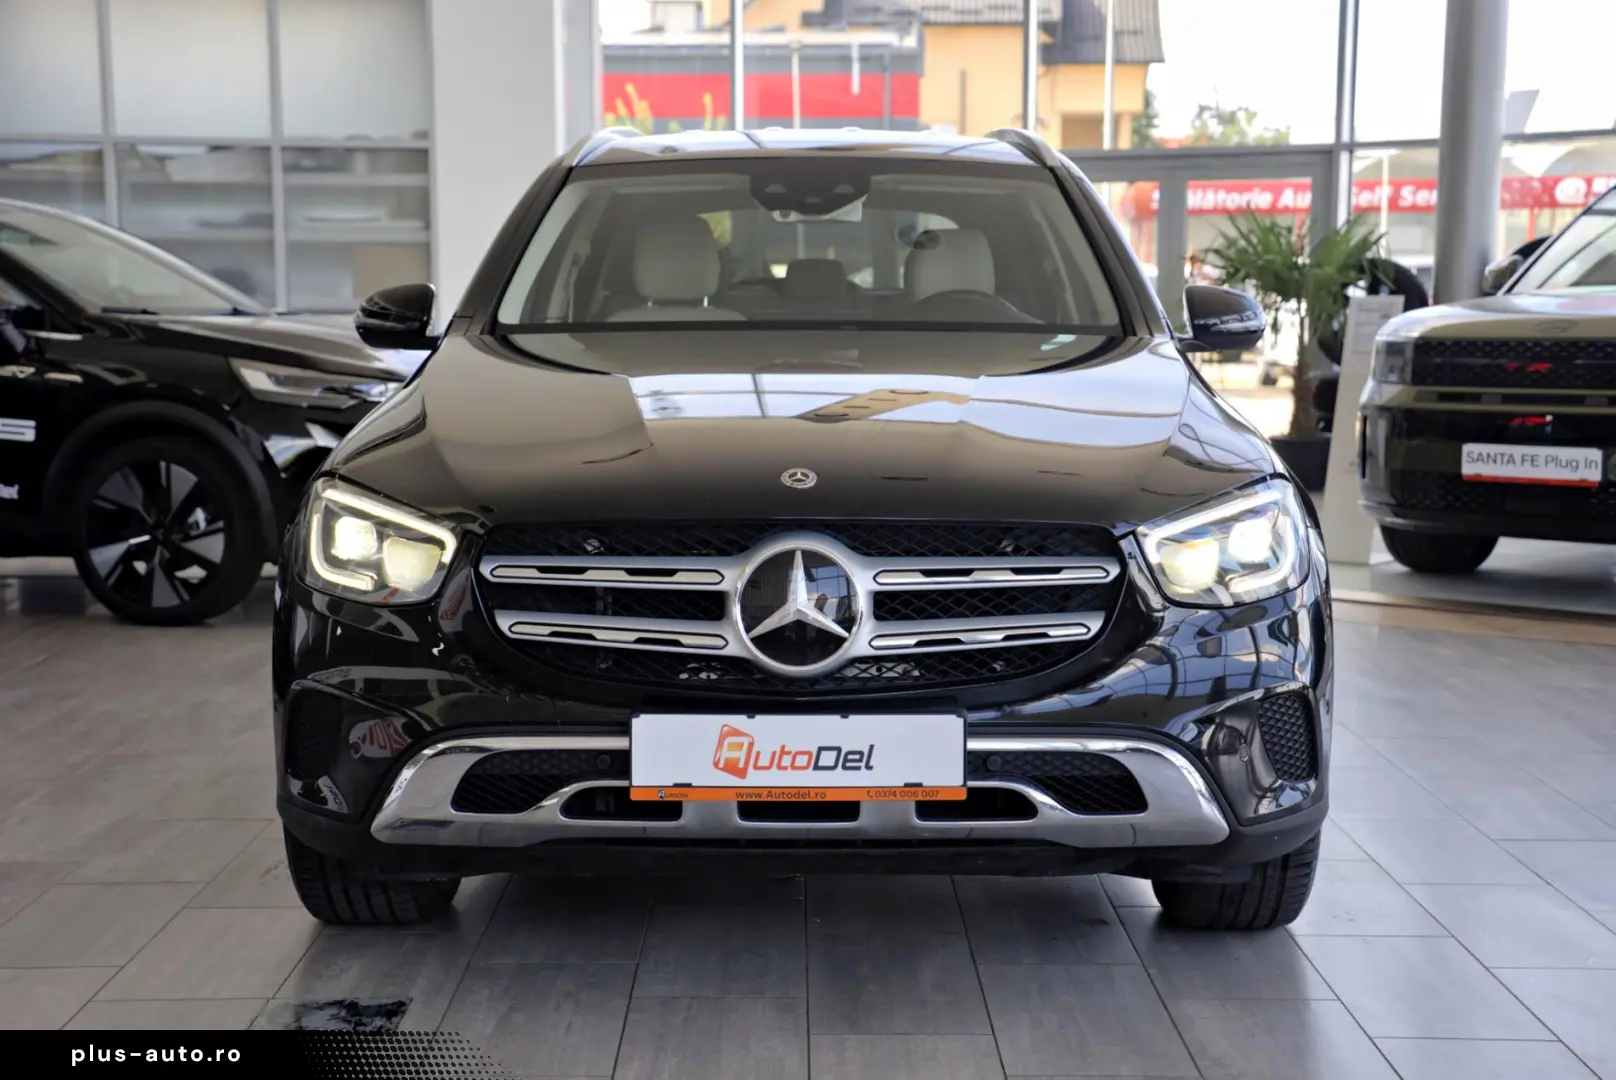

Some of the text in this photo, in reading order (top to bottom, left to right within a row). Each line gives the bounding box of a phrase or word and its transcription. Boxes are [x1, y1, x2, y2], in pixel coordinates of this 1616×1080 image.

[1465, 450, 1599, 473] SANTA FE Plug In
[716, 731, 875, 774] AutoDel
[735, 789, 827, 800] www.Autodel.ro
[875, 789, 898, 799] 0374
[921, 789, 940, 799] 007
